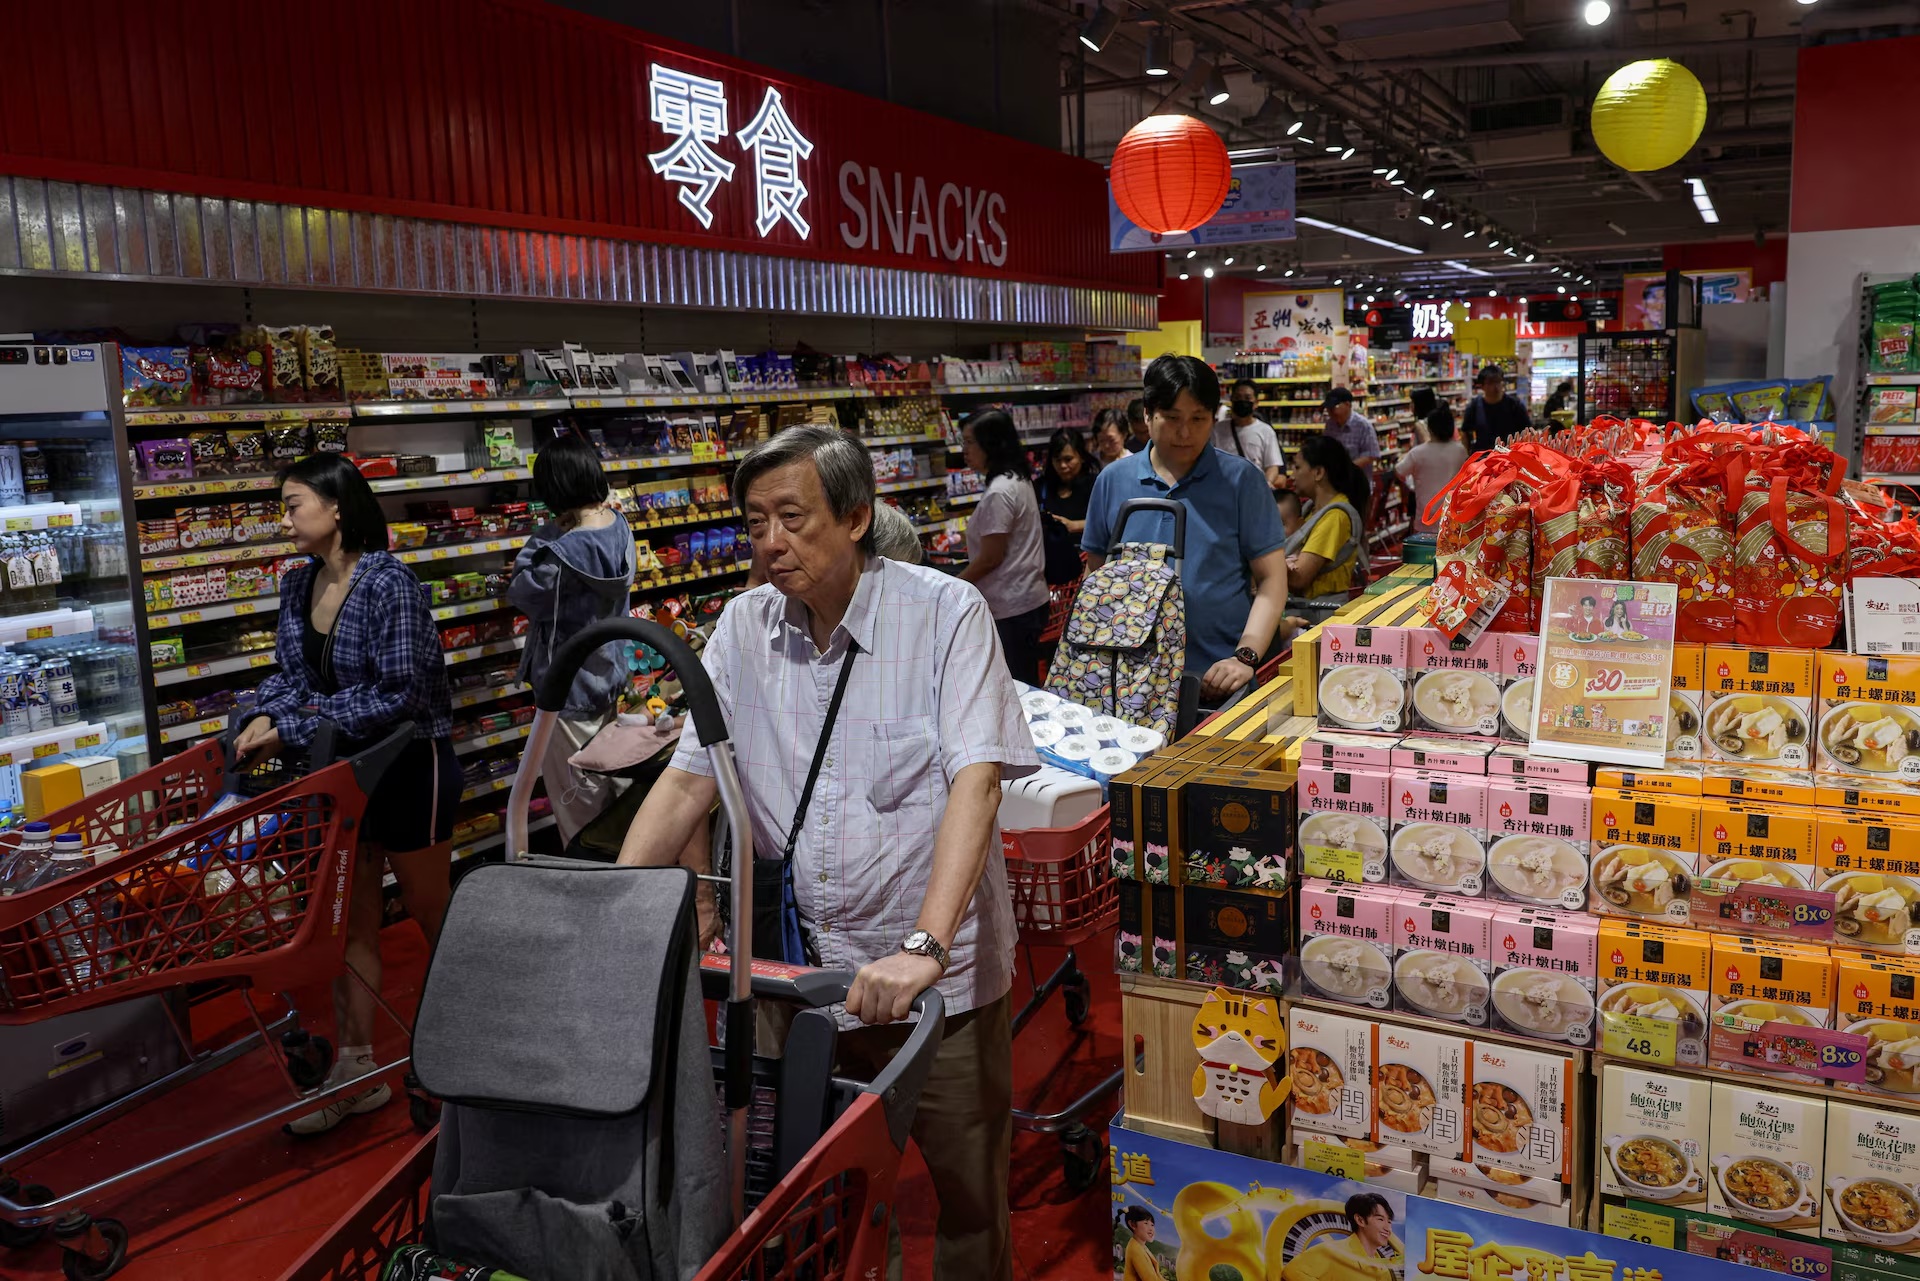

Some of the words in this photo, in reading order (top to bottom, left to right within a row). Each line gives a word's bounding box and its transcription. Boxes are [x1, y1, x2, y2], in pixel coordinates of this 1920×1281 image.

[647, 62, 814, 241] 零食
[839, 160, 1008, 267] SNACKS
[1880, 391, 1905, 400] PRETZ
[180, 526, 232, 548] CRUNKY
[232, 522, 283, 543] CRUNKY
[139, 538, 179, 554] CRUNKY
[1333, 652, 1393, 665] 杏汁燉白肺
[1427, 656, 1489, 669] 杏汁燉白肺
[1555, 665, 1573, 679] 送
[1586, 669, 1623, 693] $30
[1721, 678, 1796, 694] 爵士螺頭湯
[1837, 685, 1916, 703] 爵士螺頭湯
[1311, 797, 1374, 814] 杏汁燉白肺
[1405, 808, 1472, 825] 杏汁燉白肺
[1503, 819, 1574, 837] 杏汁燉白肺
[1607, 828, 1682, 849] 爵士螺頭湯
[336, 849, 349, 875] Fresh
[1717, 842, 1798, 862] 爵士螺頭湯
[1835, 855, 1920, 875] 爵士螺頭湯
[333, 875, 346, 924] wellcome
[1314, 919, 1378, 939] 杏汁燉白肺
[1408, 933, 1475, 955] 杏汁燉白肺
[1507, 950, 1580, 972] 杏汁燉白肺
[1614, 966, 1692, 987] 爵士螺頭湯
[1729, 982, 1811, 1005] 爵士螺頭湯
[1626, 1038, 1661, 1058] 48.0
